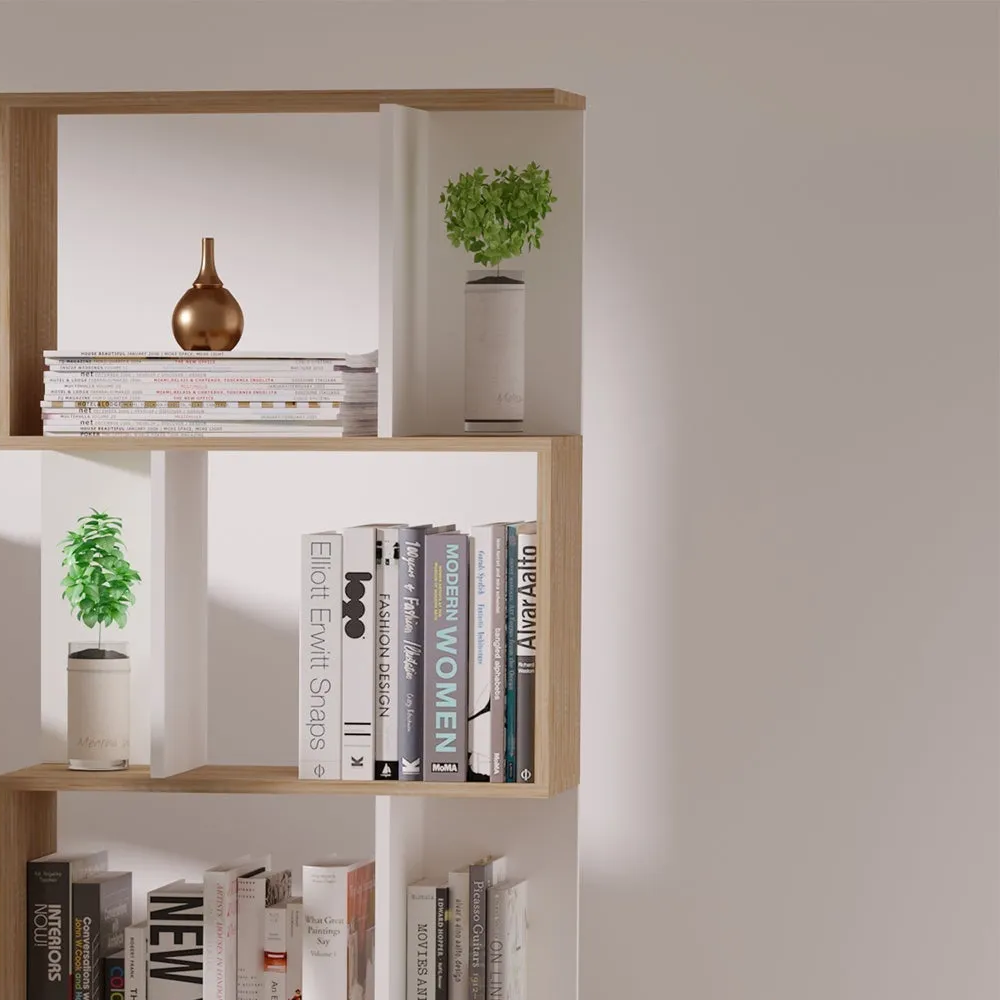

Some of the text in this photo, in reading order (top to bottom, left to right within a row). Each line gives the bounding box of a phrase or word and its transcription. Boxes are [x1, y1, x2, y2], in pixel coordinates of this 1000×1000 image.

[517, 545, 537, 650] Alvar Aalto
[306, 541, 332, 750] Elliott Erwitt Snaps
[379, 593, 391, 717] FASHION DESIGN
[435, 543, 460, 753] MODERN WOMEN
[493, 628, 501, 658] tangled
[432, 763, 458, 773] MoMA
[304, 915, 323, 924] What
[473, 880, 484, 921] Picasso
[34, 903, 48, 947] NOW!
[48, 904, 62, 981] INTERIORS
[74, 917, 83, 939] John
[150, 896, 203, 985] NEW
[308, 926, 340, 936] Paintings
[316, 937, 330, 948] Say
[472, 923, 484, 968] Guitars
[82, 916, 92, 990] Conversations
[216, 957, 223, 966] IN
[417, 923, 428, 976] MOVIES
[490, 940, 503, 963] ON
[74, 972, 82, 990] and
[271, 980, 278, 993] An
